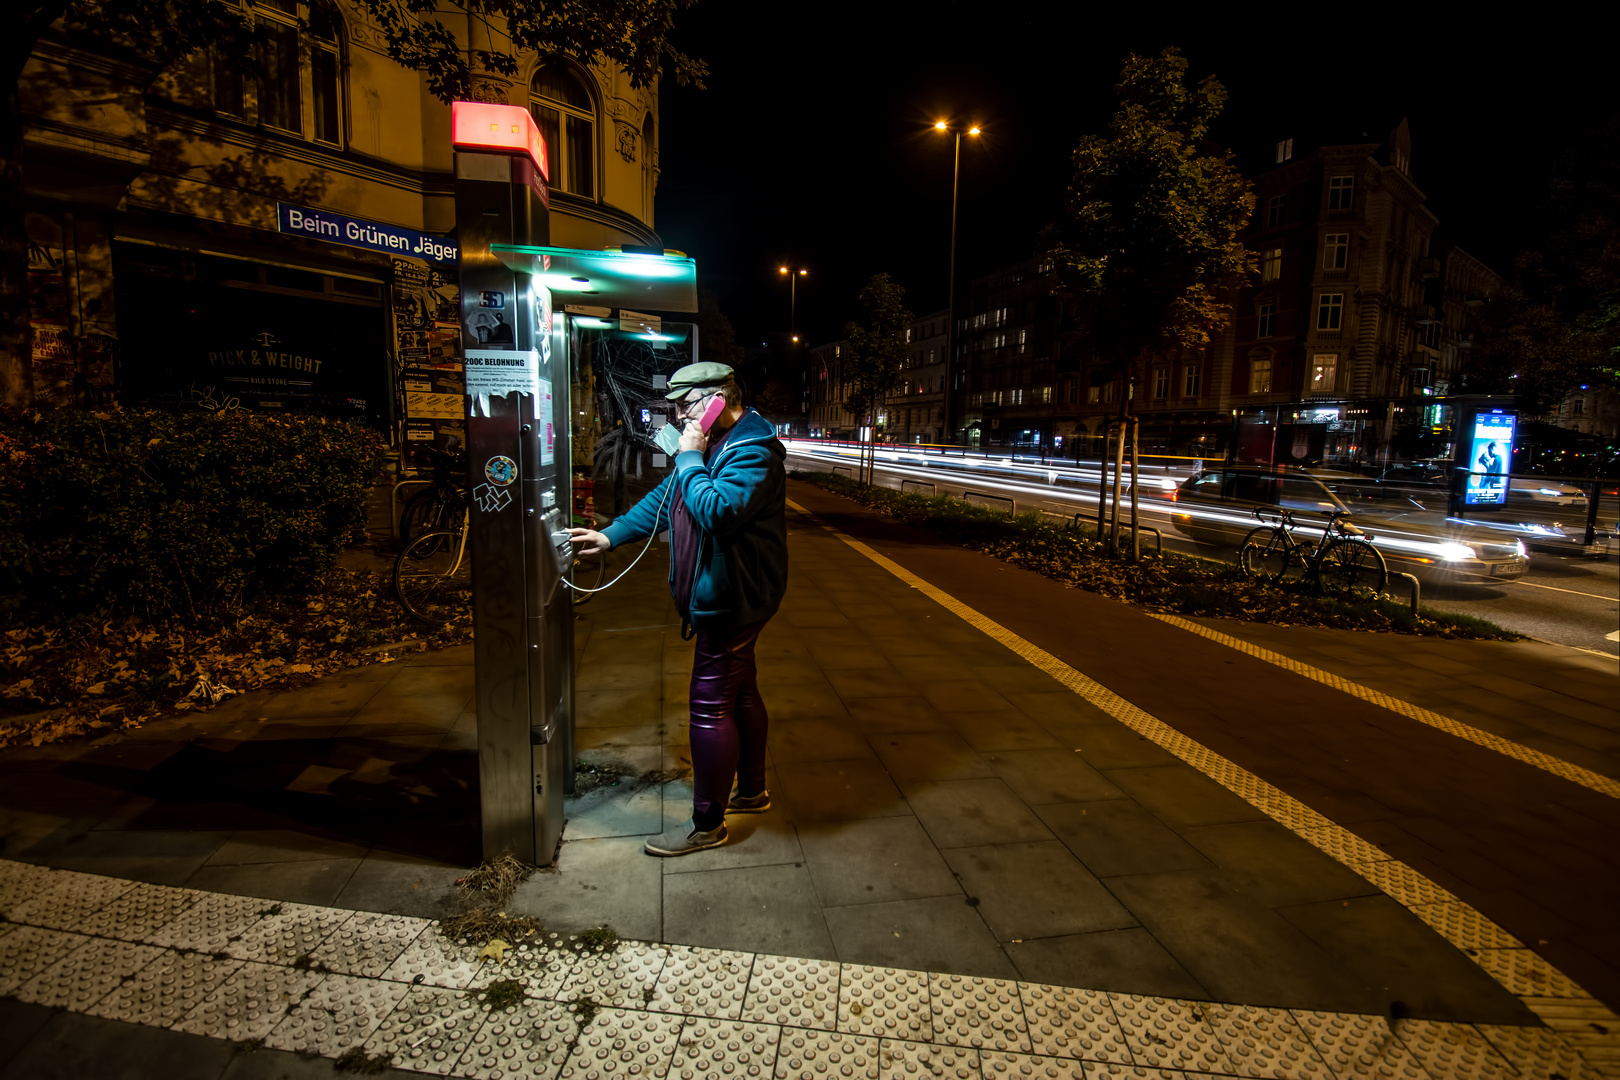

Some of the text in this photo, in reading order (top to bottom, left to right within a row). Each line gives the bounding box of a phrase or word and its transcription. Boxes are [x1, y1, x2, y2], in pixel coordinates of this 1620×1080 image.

[289, 209, 458, 261] Beim Grünen Jäger
[208, 348, 323, 376] PICK & WEIGHT
[465, 357, 525, 367] 200€ BELOHNUNG
[268, 378, 288, 386] STORE
